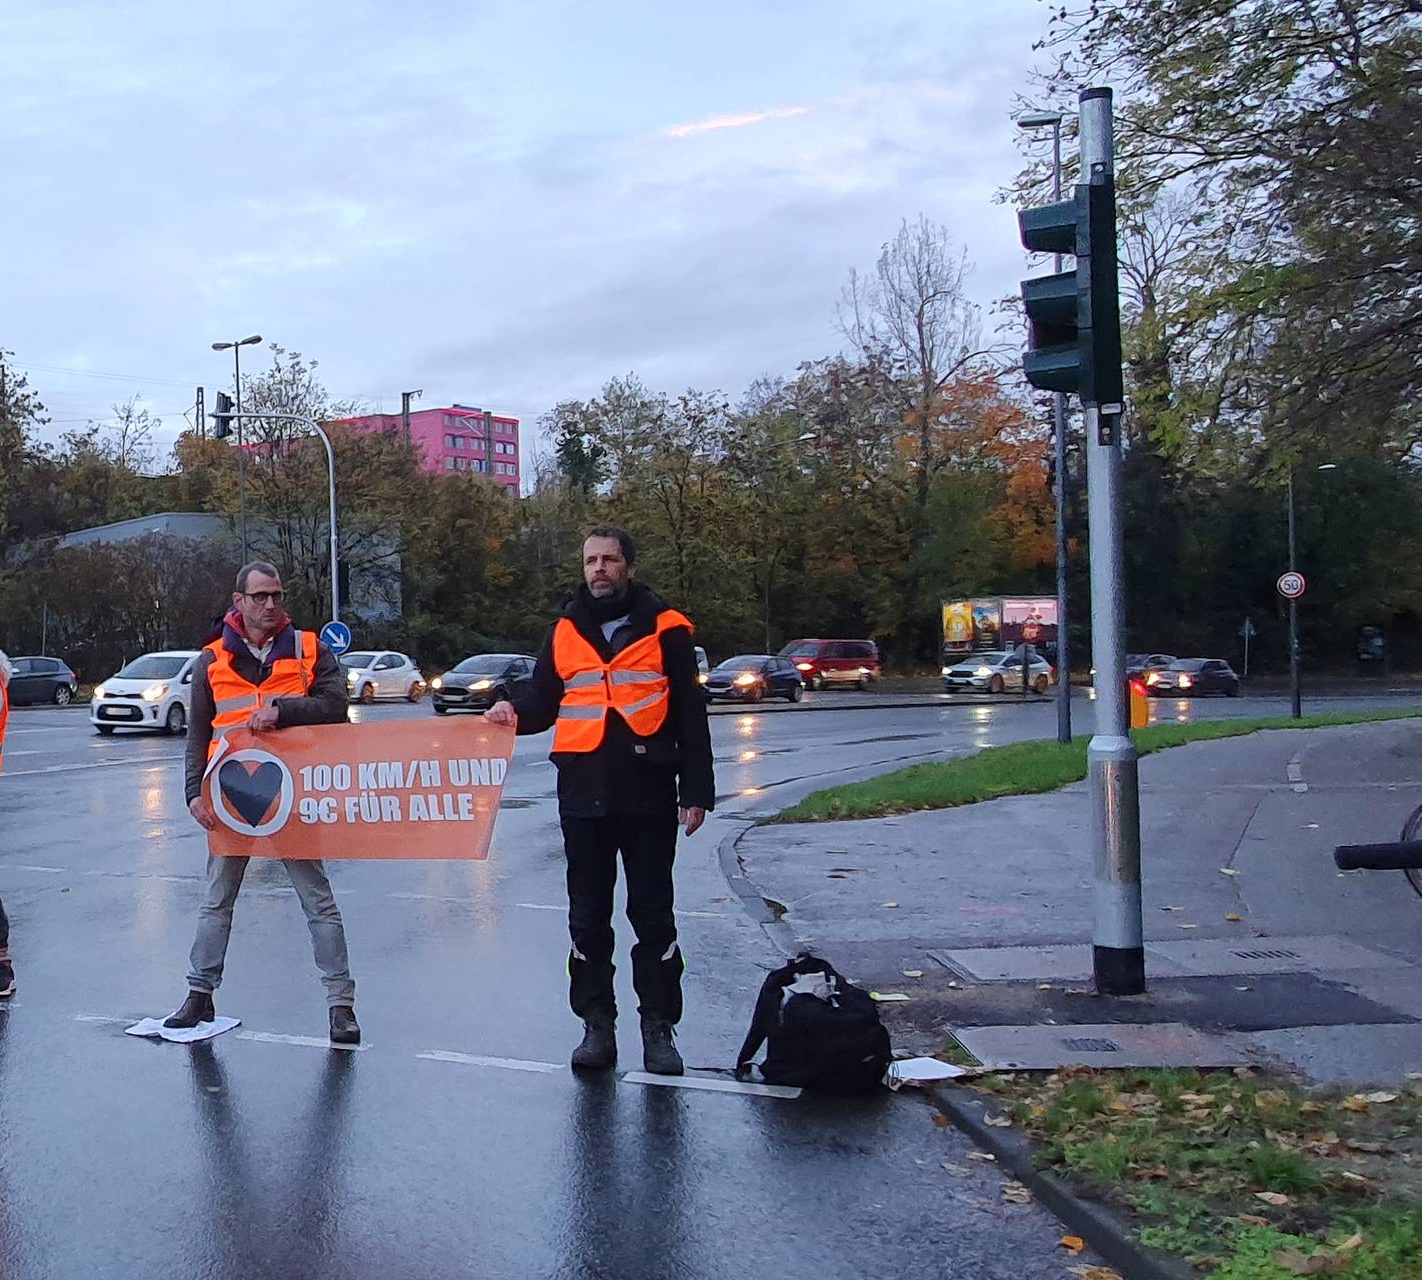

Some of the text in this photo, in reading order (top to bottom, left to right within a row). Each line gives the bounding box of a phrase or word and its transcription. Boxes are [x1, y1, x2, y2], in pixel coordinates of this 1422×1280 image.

[1283, 579, 1299, 591] 50
[299, 757, 508, 792] 100 KM/H UND
[298, 790, 475, 824] 9€ FÜR ALLE
